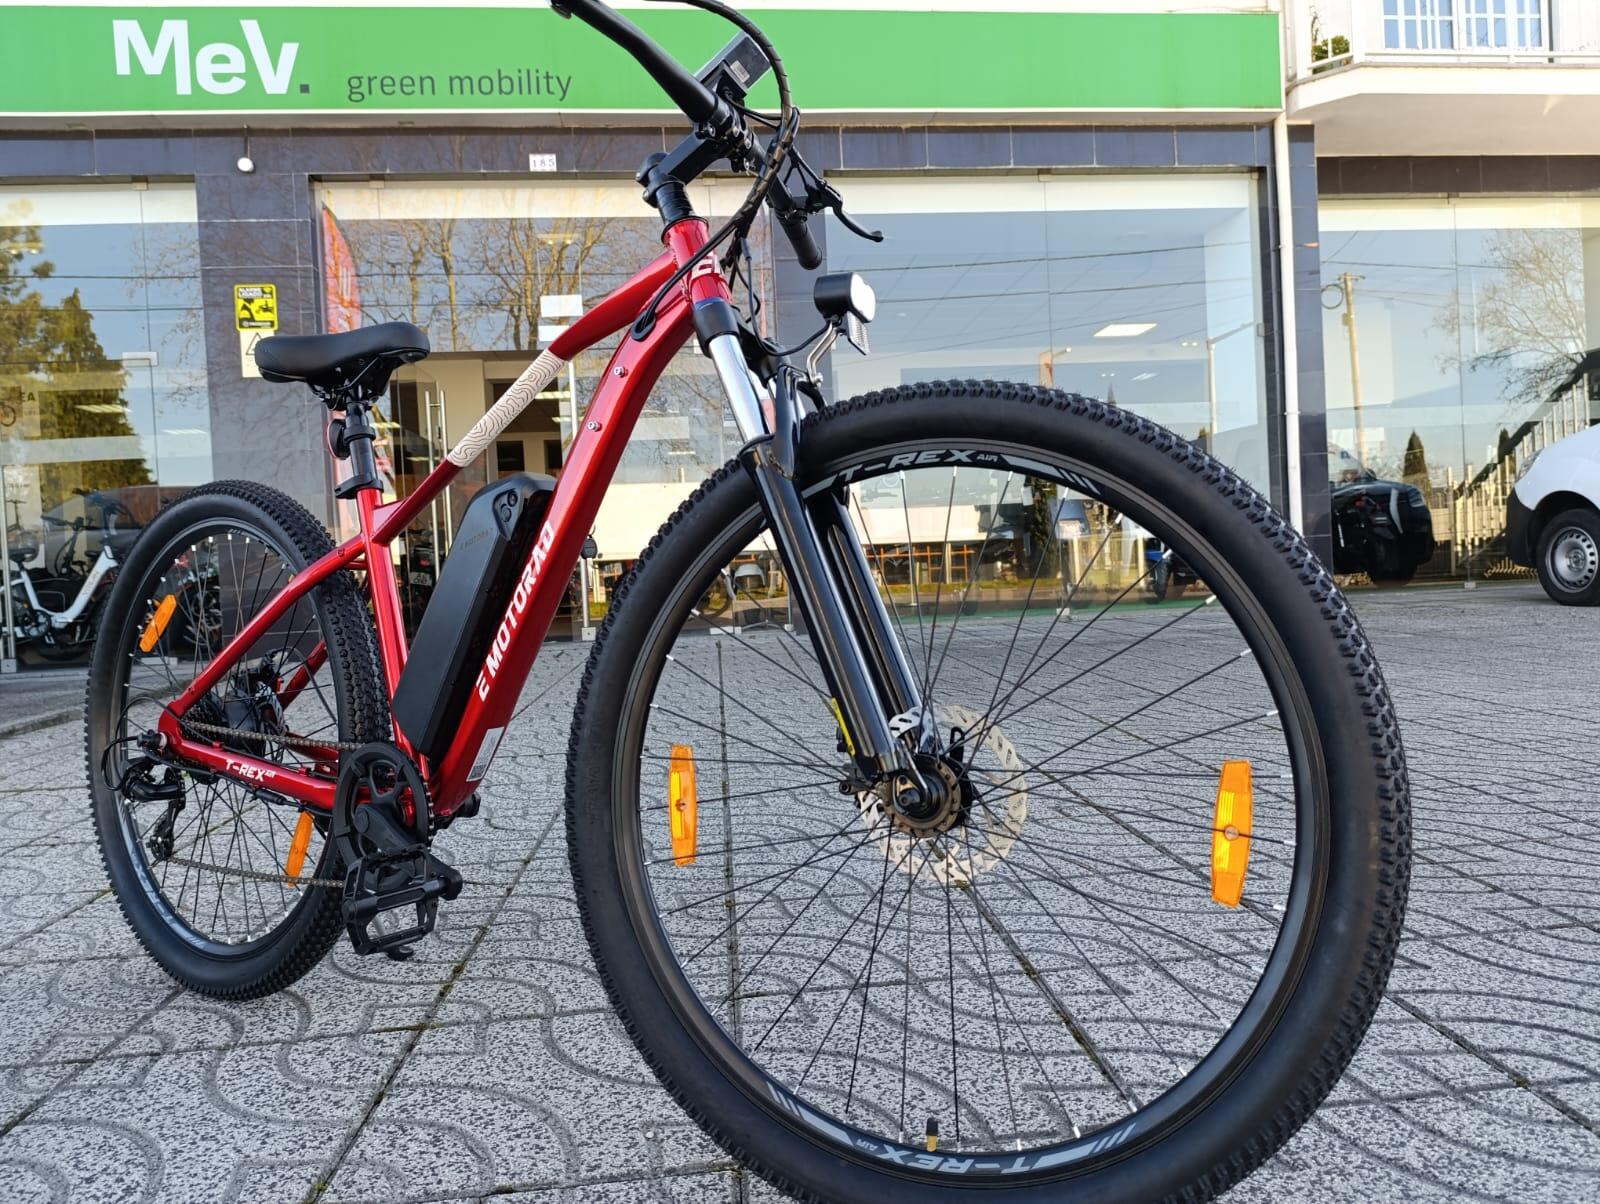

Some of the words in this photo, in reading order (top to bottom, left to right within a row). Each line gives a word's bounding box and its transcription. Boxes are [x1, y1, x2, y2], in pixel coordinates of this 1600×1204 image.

[347, 75, 436, 103] green
[448, 68, 572, 102] mobility
[839, 449, 976, 483] T-REX
[976, 453, 998, 462] AIR
[225, 759, 265, 782] T-REX
[877, 1144, 1032, 1174] T-REX
